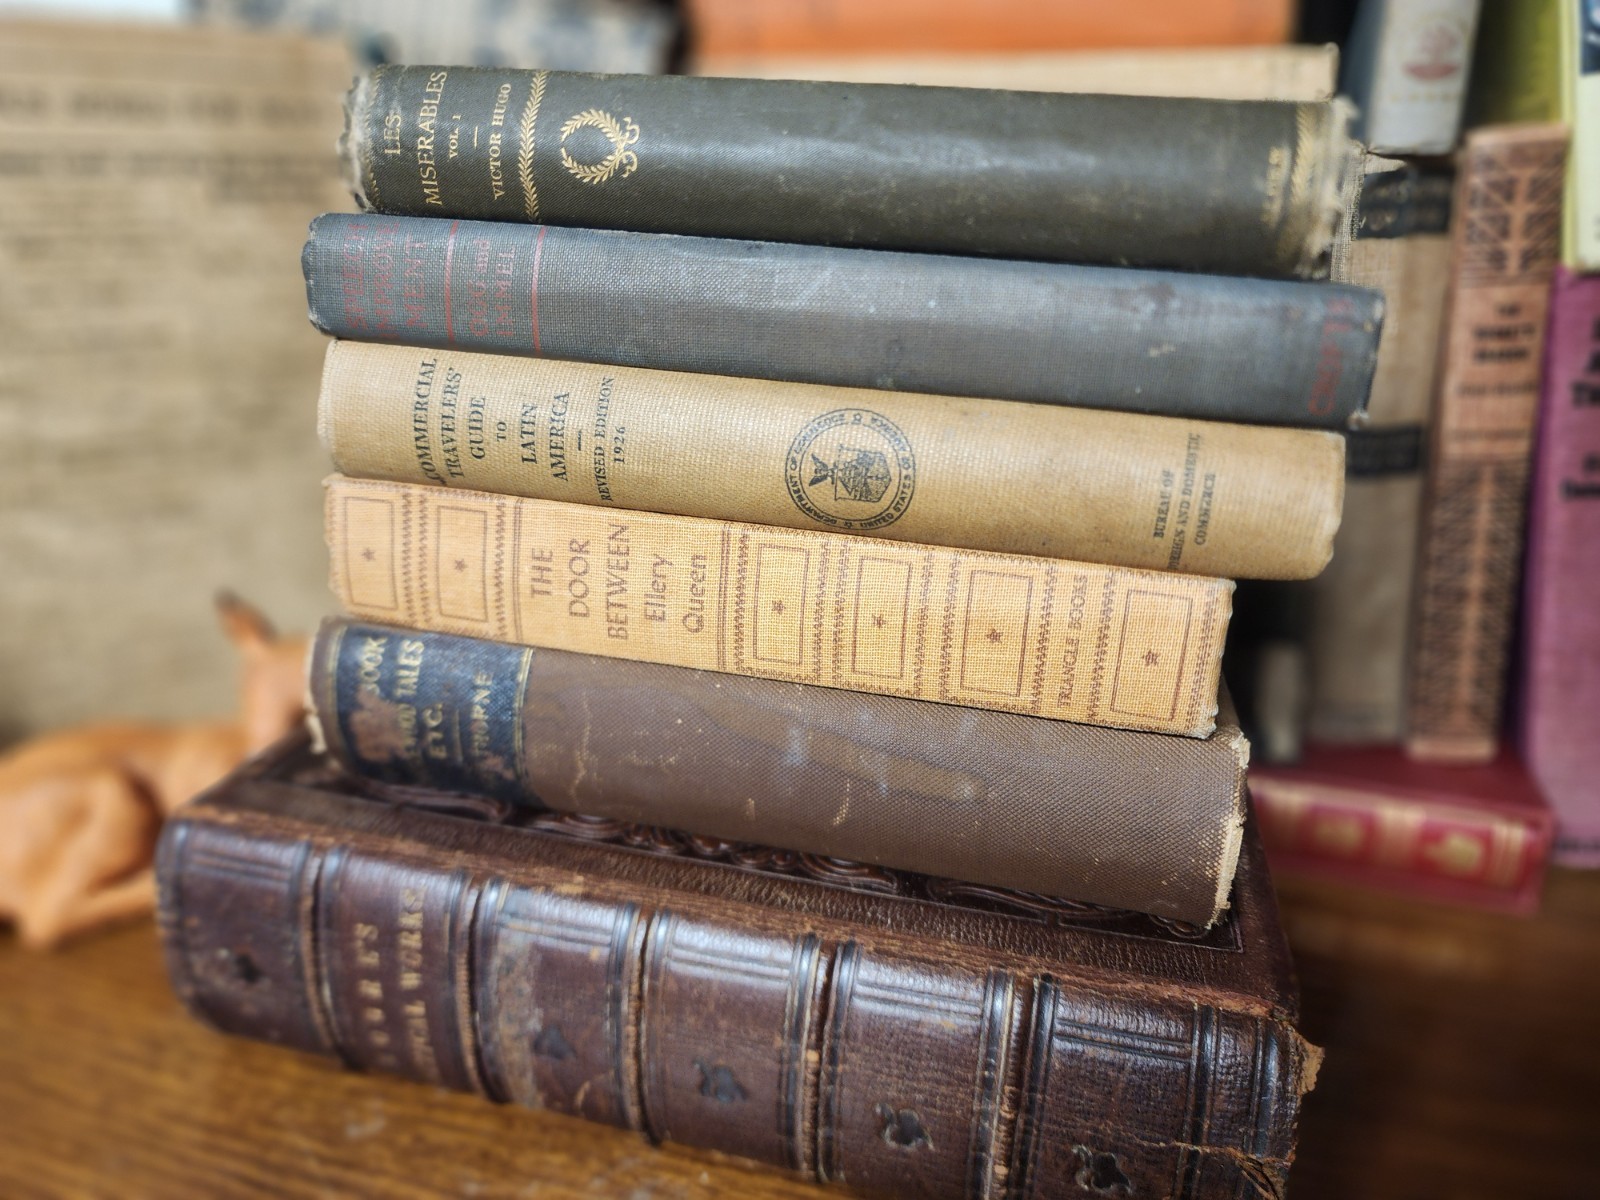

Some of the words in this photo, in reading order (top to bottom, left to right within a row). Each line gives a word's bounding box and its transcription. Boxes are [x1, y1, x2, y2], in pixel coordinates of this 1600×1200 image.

[383, 114, 402, 156] LES
[491, 83, 512, 126] HUGO
[417, 71, 448, 206] MISERABLES
[447, 128, 460, 159] VOL.
[488, 132, 506, 200] VICTOR
[343, 223, 368, 330] SPEECH
[403, 232, 428, 328] MENT
[473, 239, 490, 274] and
[413, 358, 446, 485] COMMERCIAL
[440, 367, 465, 478] TRAVELERS'
[468, 396, 486, 460] GUIDE
[496, 421, 508, 442] TO
[521, 403, 538, 465] LATIN
[549, 391, 570, 482] AMERICA
[594, 376, 614, 438] EDITION
[593, 446, 613, 502] REVISED
[613, 426, 626, 464] 1926
[859, 511, 894, 530] UNITED
[892, 474, 912, 514] STATES
[1152, 491, 1172, 539] BUREAU
[1176, 500, 1191, 527] AND
[531, 547, 554, 598] THE
[568, 538, 591, 618] DOOR
[605, 522, 630, 640] BETWEEN
[643, 553, 673, 622] Ellery
[681, 554, 707, 633] Queen
[395, 639, 425, 700] TALES
[1056, 636, 1080, 709] TRIANGLE
